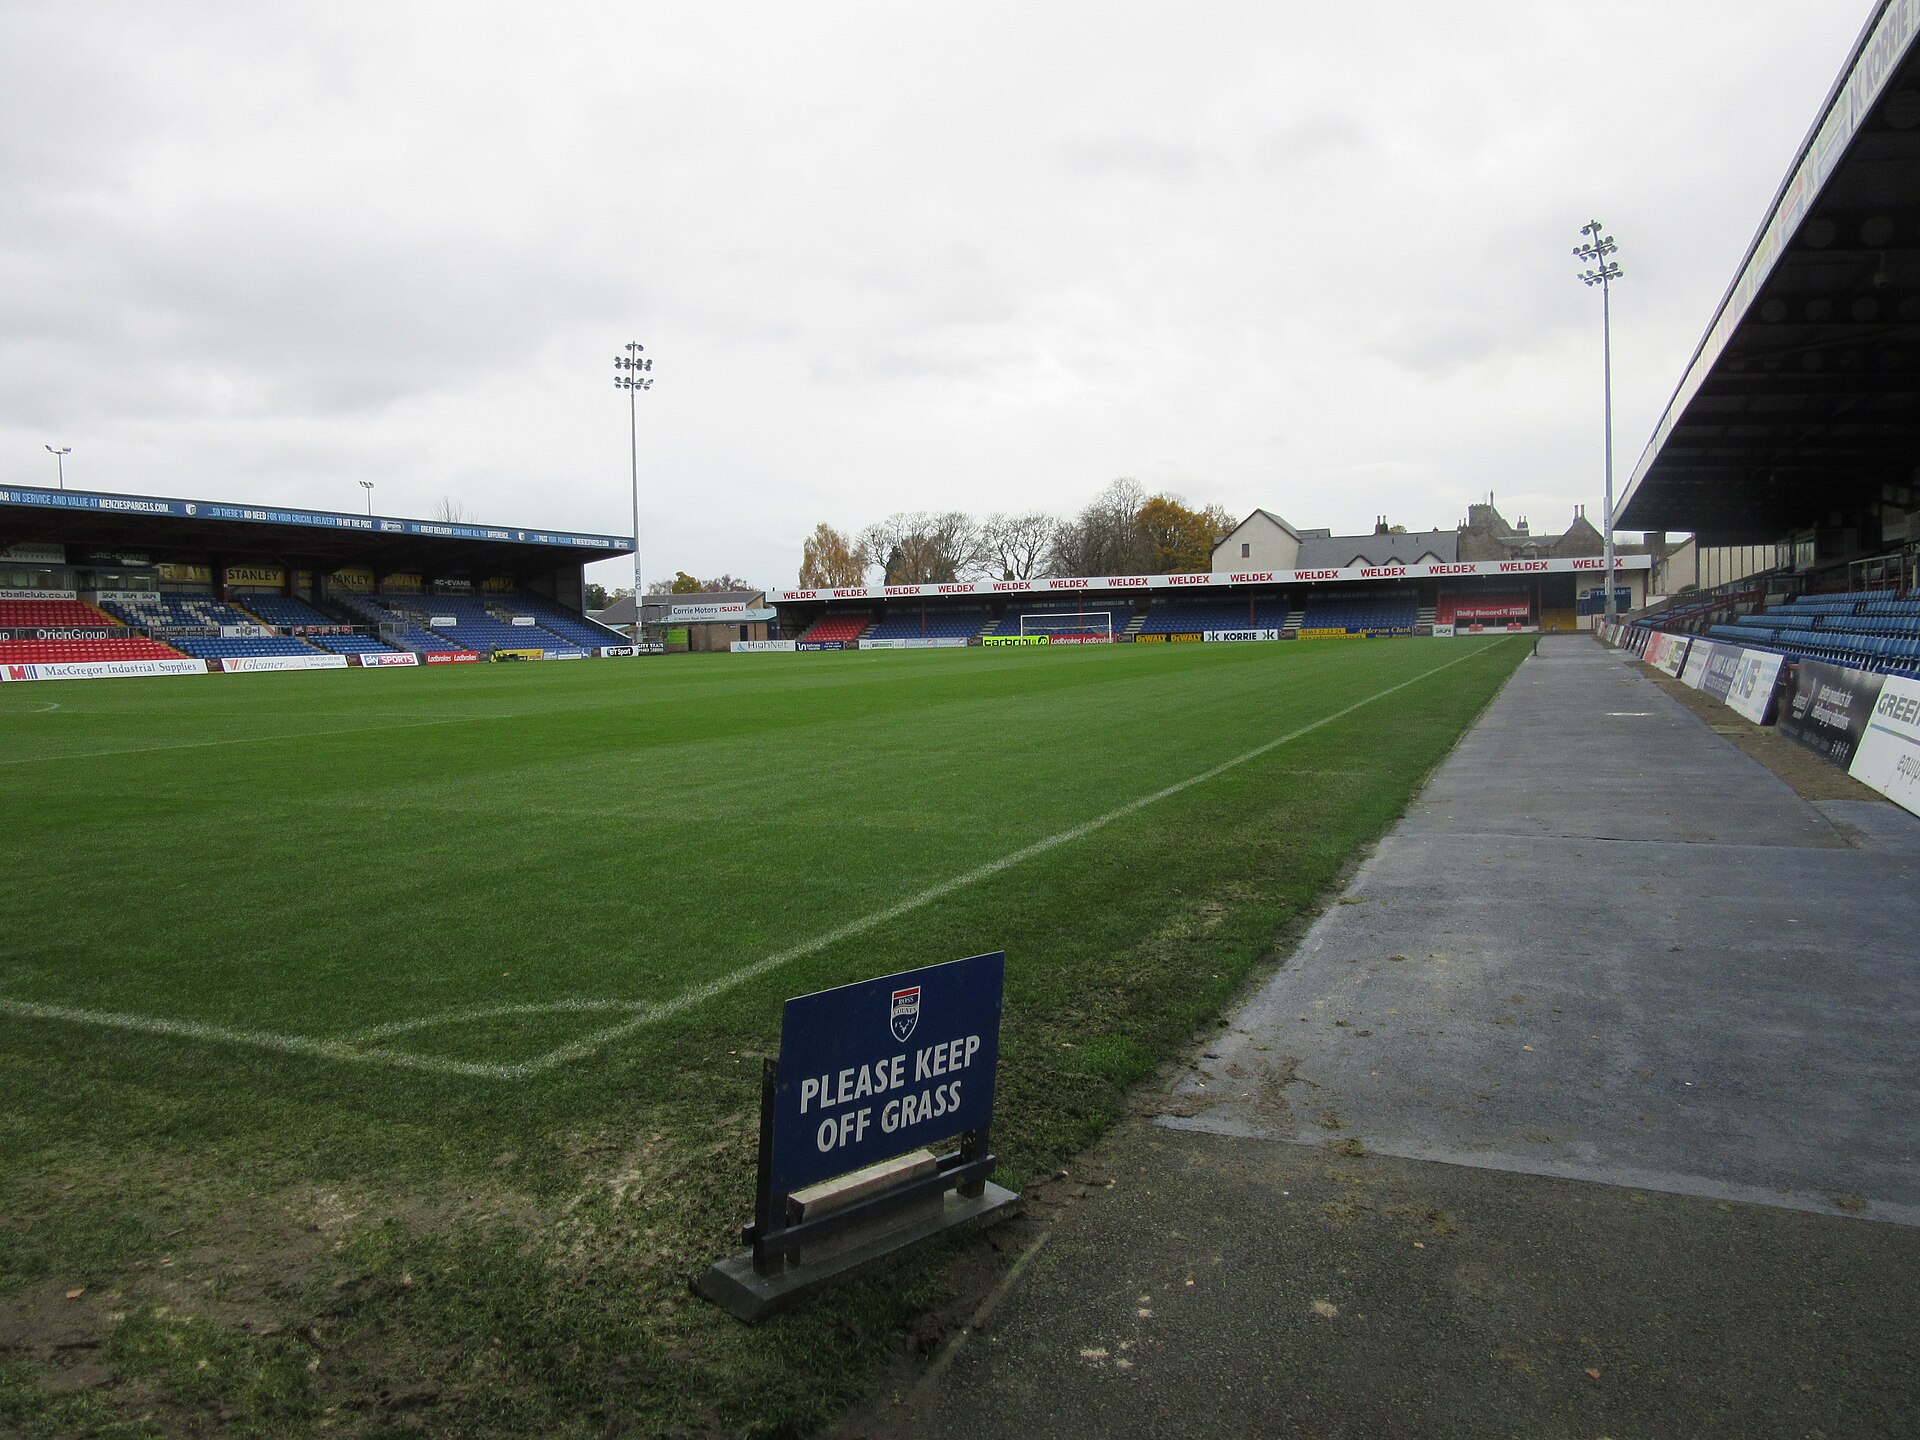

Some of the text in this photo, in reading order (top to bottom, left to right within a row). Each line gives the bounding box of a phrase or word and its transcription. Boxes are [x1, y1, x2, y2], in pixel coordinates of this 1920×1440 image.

[11, 492, 20, 502] ON
[22, 493, 50, 504] SERVICE
[52, 496, 66, 505] AND
[68, 497, 89, 507] VALUE
[90, 499, 98, 508] AT
[221, 508, 244, 518] THERE'S
[244, 510, 252, 519] NO
[253, 511, 266, 520] NEED
[278, 513, 292, 522] YOUR
[292, 515, 312, 524] CRUCIAL
[313, 516, 336, 526] DELIVERY
[336, 518, 342, 526] TO
[343, 519, 351, 527] HIT
[352, 519, 360, 528] THE
[361, 520, 372, 529] POST
[228, 569, 279, 581] STANLEY
[783, 558, 1623, 600] WELDEX WELDEX WELDEX WELDEX WELDEX WELDEX WELDEX WELDEX WELDEX WELDEX WELDEX WELDEX WELDEX WELDX
[673, 607, 694, 615] Corrie
[694, 606, 718, 614] Motors
[36, 628, 107, 641] OrionGroup
[1223, 632, 1257, 641] KORRIE
[748, 641, 789, 650] HighNet
[1050, 637, 1082, 645] Ladbrokes
[617, 648, 631, 657] Sport
[366, 655, 414, 668] sky SPORTS
[427, 654, 477, 663] Ladbrokes Ladbrokes
[44, 661, 197, 677] MacGregor Industrial Supplies
[243, 659, 285, 670] Gleaner
[898, 995, 914, 1005] ROSS
[893, 1007, 918, 1015] COUNTY
[800, 1035, 981, 1115] PLEASE KEEP
[816, 1080, 962, 1153] OFF GRASS
